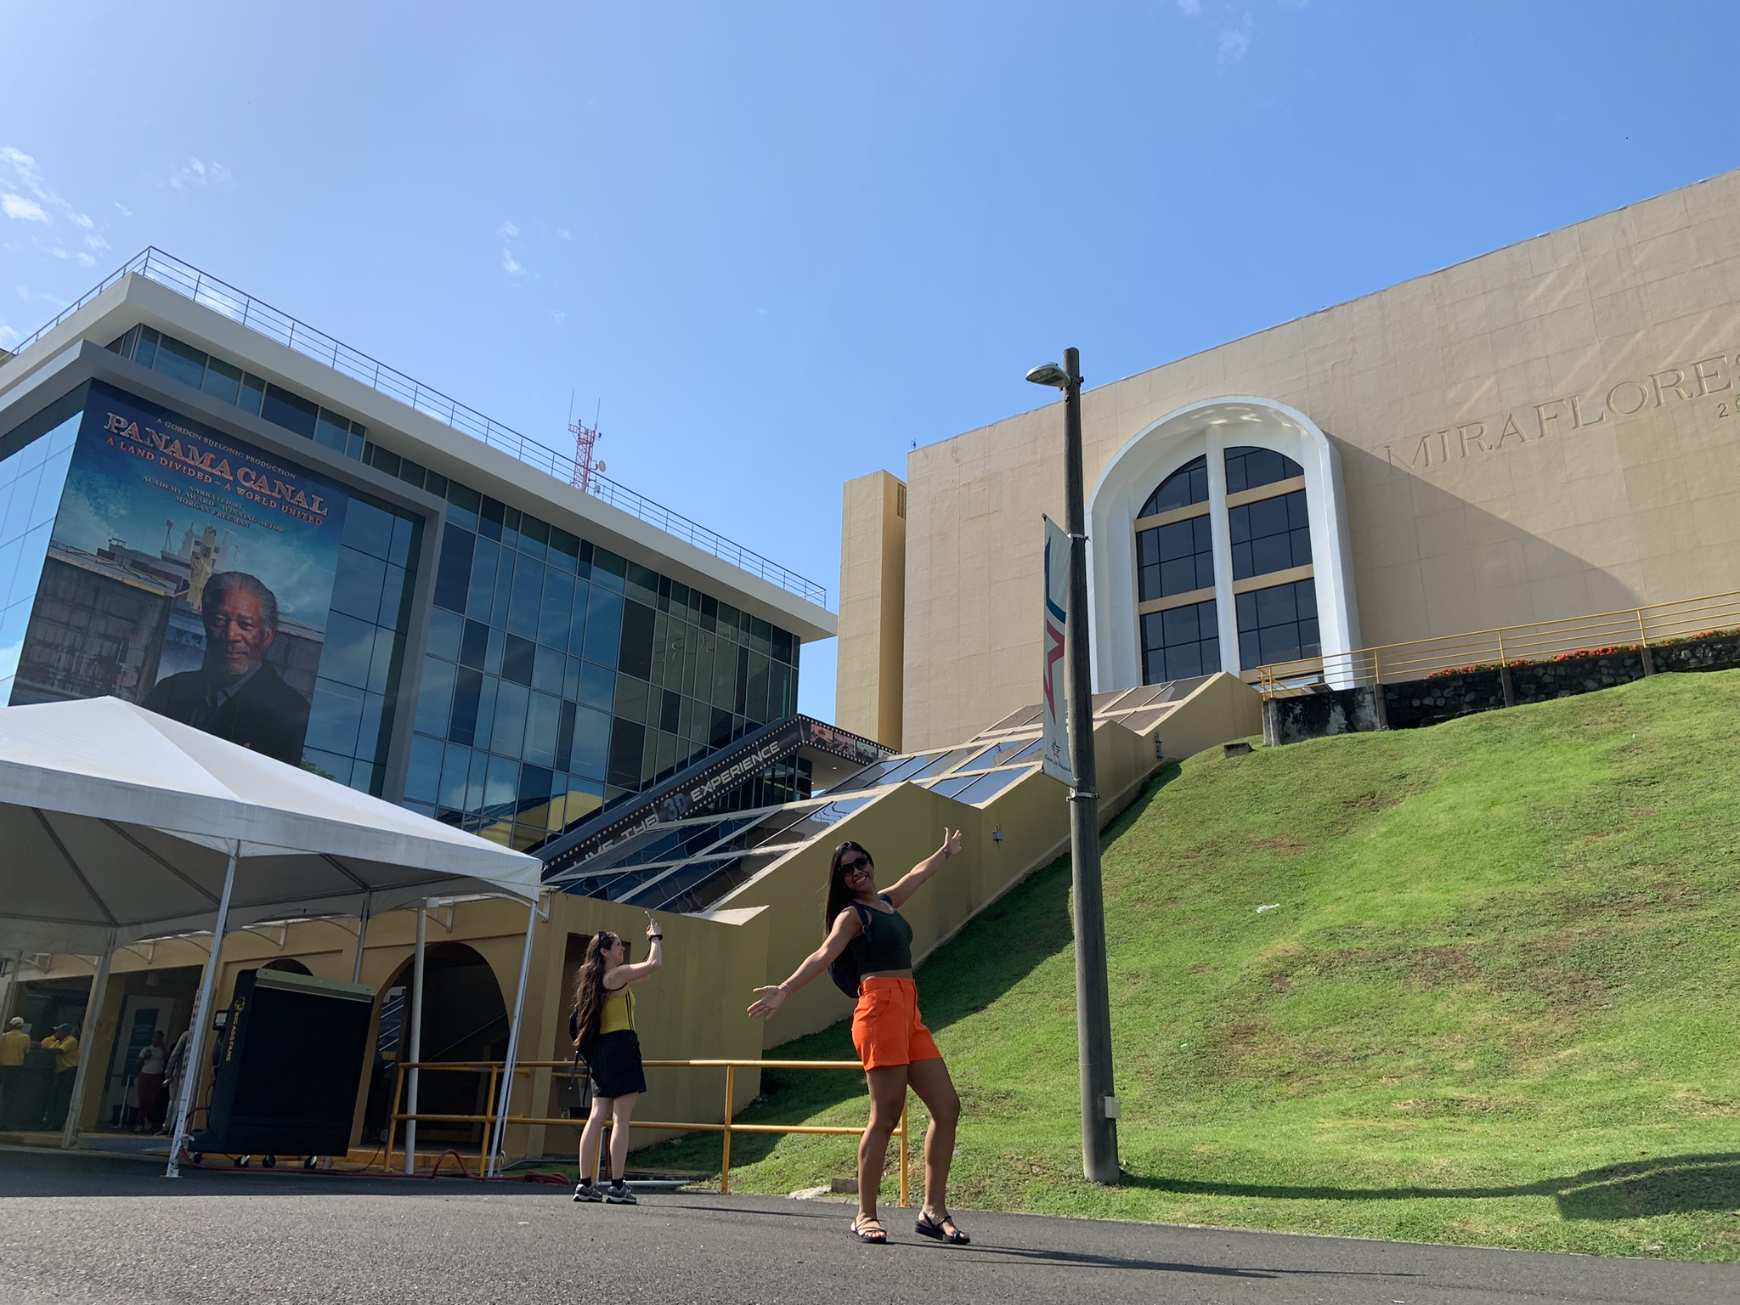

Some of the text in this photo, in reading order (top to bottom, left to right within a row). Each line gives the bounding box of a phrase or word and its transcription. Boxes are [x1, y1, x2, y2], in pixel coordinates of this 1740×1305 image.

[1383, 353, 1740, 468] MIRAFLORE
[103, 411, 233, 481] PANAMA
[236, 466, 328, 516] CANAL
[105, 435, 115, 447] A
[120, 441, 155, 461] LAND
[159, 457, 212, 483] DIVIDED
[236, 486, 277, 509] WORLD
[281, 505, 323, 526] UNITED
[245, 454, 297, 480] PRODUCTION
[620, 813, 657, 840] THE
[691, 740, 780, 802] EXPERIENCE
